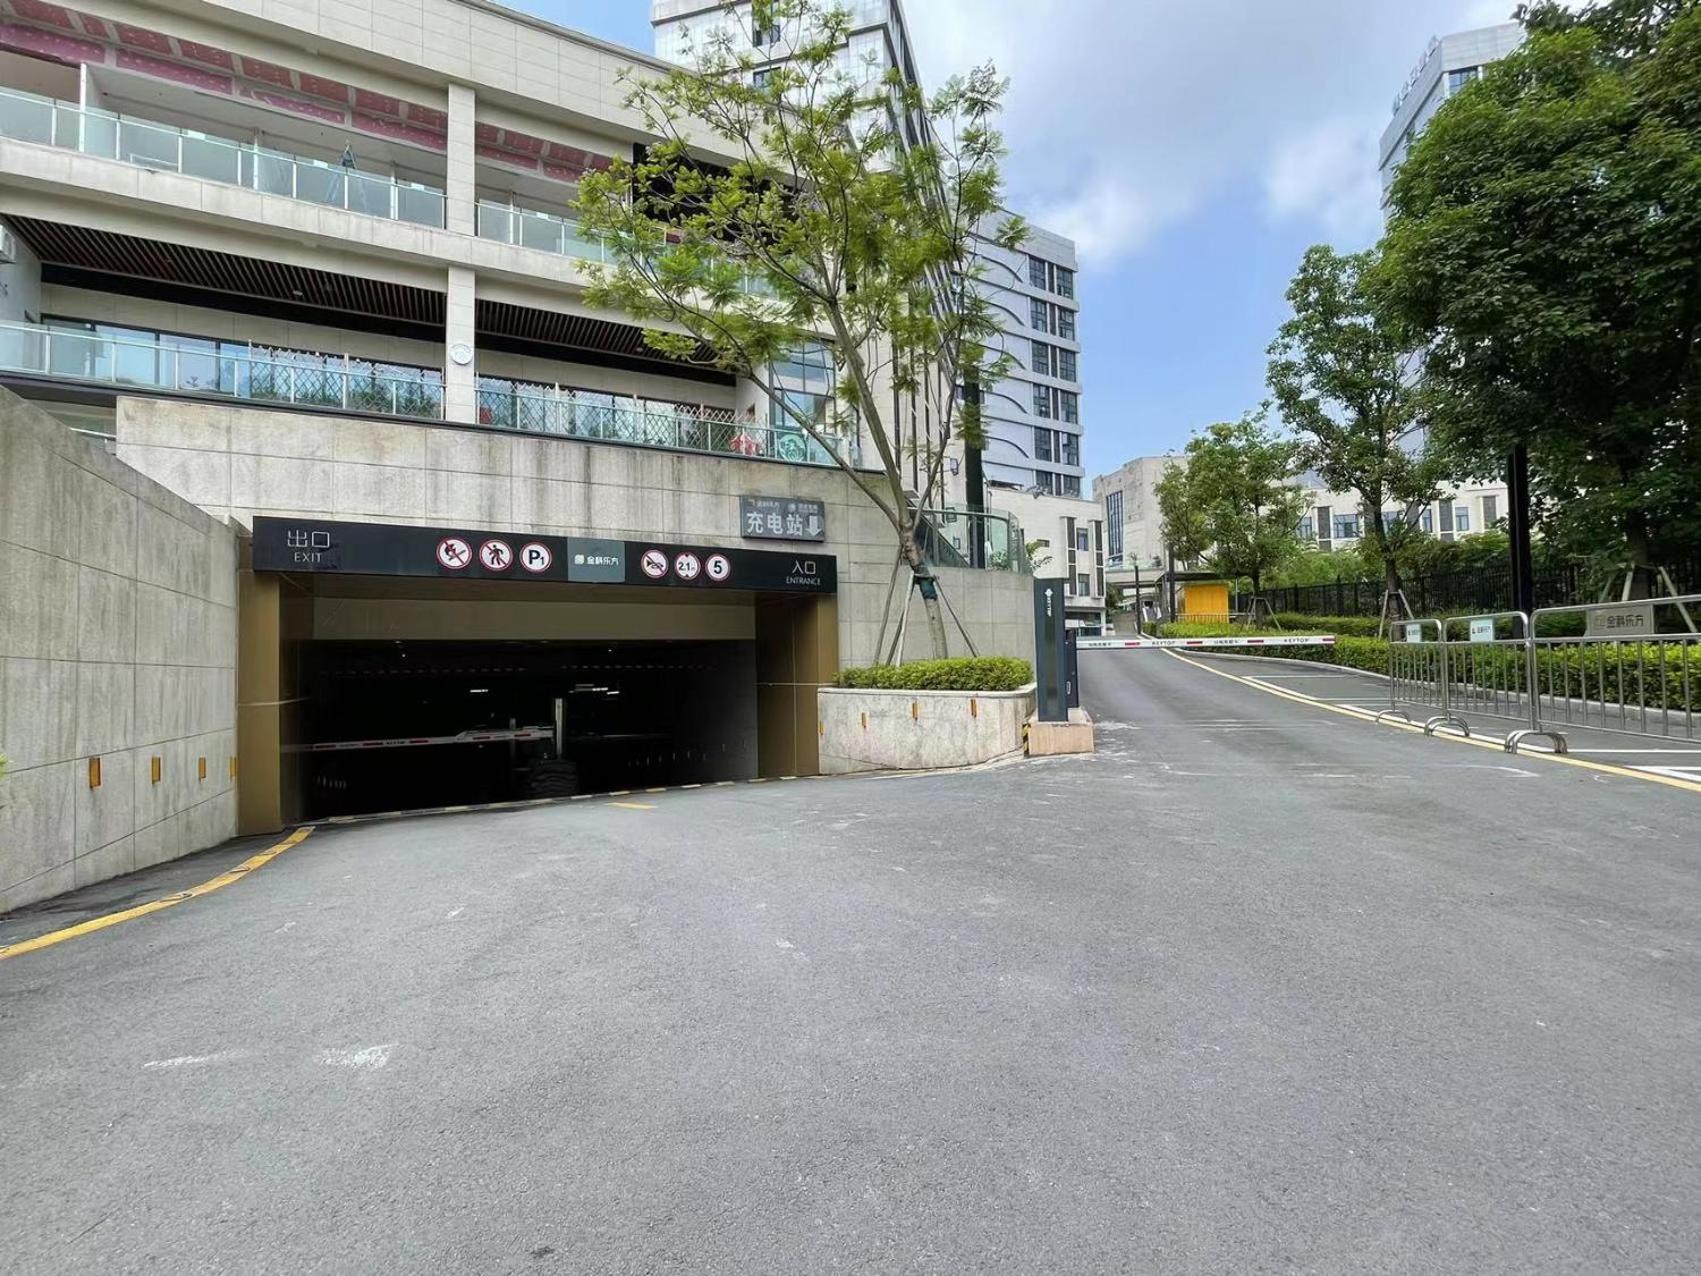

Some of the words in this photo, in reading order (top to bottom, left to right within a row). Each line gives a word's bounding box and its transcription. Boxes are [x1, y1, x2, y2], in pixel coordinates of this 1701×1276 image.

[746, 511, 803, 536] 充电站
[287, 529, 330, 548] 出口
[294, 551, 323, 563] EXIT
[713, 560, 723, 575] 5
[791, 559, 816, 575] 入口
[785, 575, 821, 586] ENTRANCE
